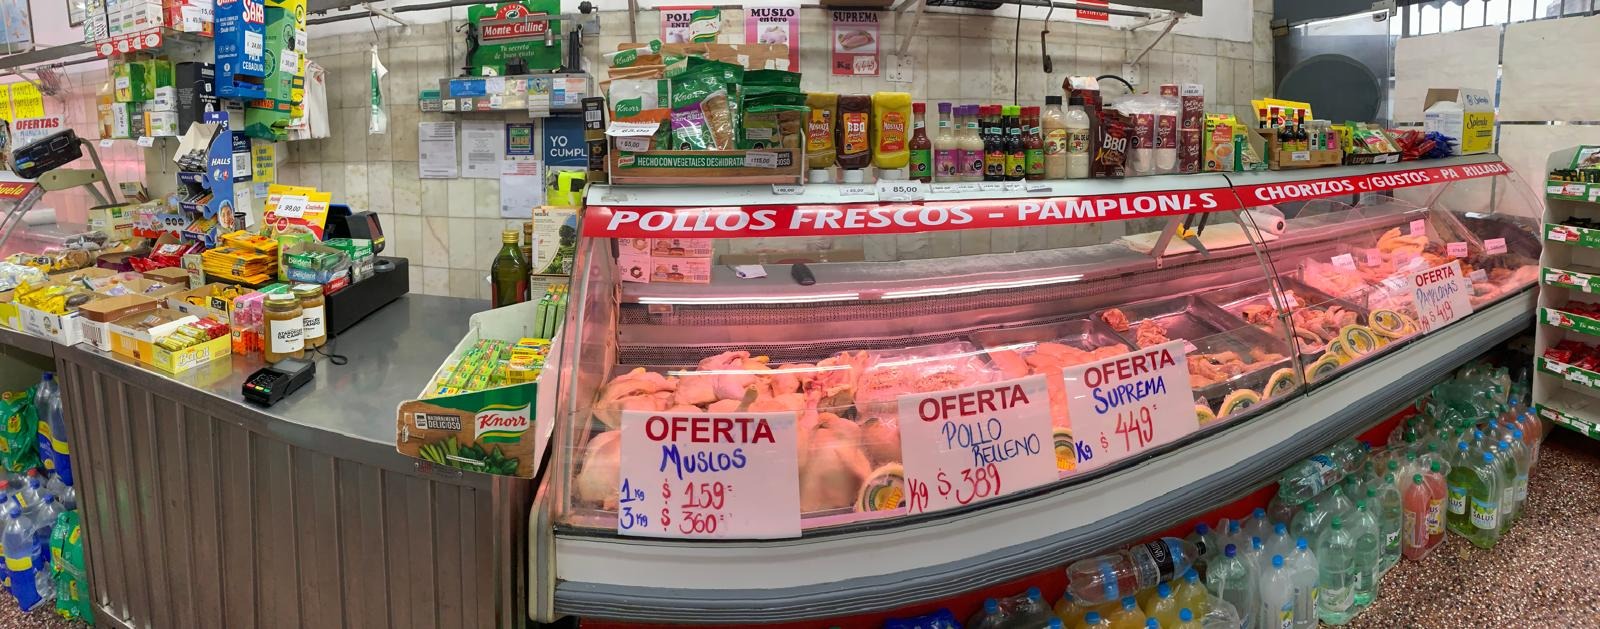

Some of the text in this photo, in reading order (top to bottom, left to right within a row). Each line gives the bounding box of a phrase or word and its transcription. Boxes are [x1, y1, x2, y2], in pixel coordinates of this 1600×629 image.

[750, 8, 795, 17] MUSLO
[833, 11, 878, 22] SUPREMA
[484, 26, 511, 36] Monte
[616, 104, 639, 112] Knorr
[16, 118, 59, 130] OFERTAS
[1467, 114, 1487, 129] Splenda
[550, 136, 567, 147] YO
[1103, 133, 1127, 153] BBQ
[211, 158, 231, 166] HALLS
[550, 148, 587, 157] CUMPL
[637, 157, 659, 166] HECHO
[659, 157, 673, 166] CON
[674, 157, 705, 166] VEGETALES
[706, 157, 746, 167] DESHIDRATA
[1254, 179, 1354, 202] CHORIZOS
[1358, 171, 1430, 191] c/GUSTOS
[1463, 163, 1505, 178] RILLADA
[606, 208, 778, 232] POLLOS
[788, 205, 973, 230] FRESCOS
[1415, 266, 1454, 287] OFERTA
[1416, 280, 1458, 309] PAMPLONAS
[1084, 349, 1175, 389] OFERTA
[919, 384, 1030, 422] OFERTA
[1092, 376, 1167, 415] SUPREMA
[428, 421, 461, 430] DELICIOSO
[477, 413, 528, 429] Knorr
[645, 416, 776, 444] OFERTA
[941, 418, 1002, 450] POLLO
[972, 433, 1041, 468] RELLENO
[1075, 440, 1093, 463] Kg
[1100, 431, 1109, 453] $
[660, 444, 746, 480] MUSLOS
[662, 478, 671, 504] $
[907, 463, 1001, 513] Kg $ 389
[620, 507, 634, 530] 3
[661, 507, 670, 531] $
[1473, 511, 1493, 521] SALUS
